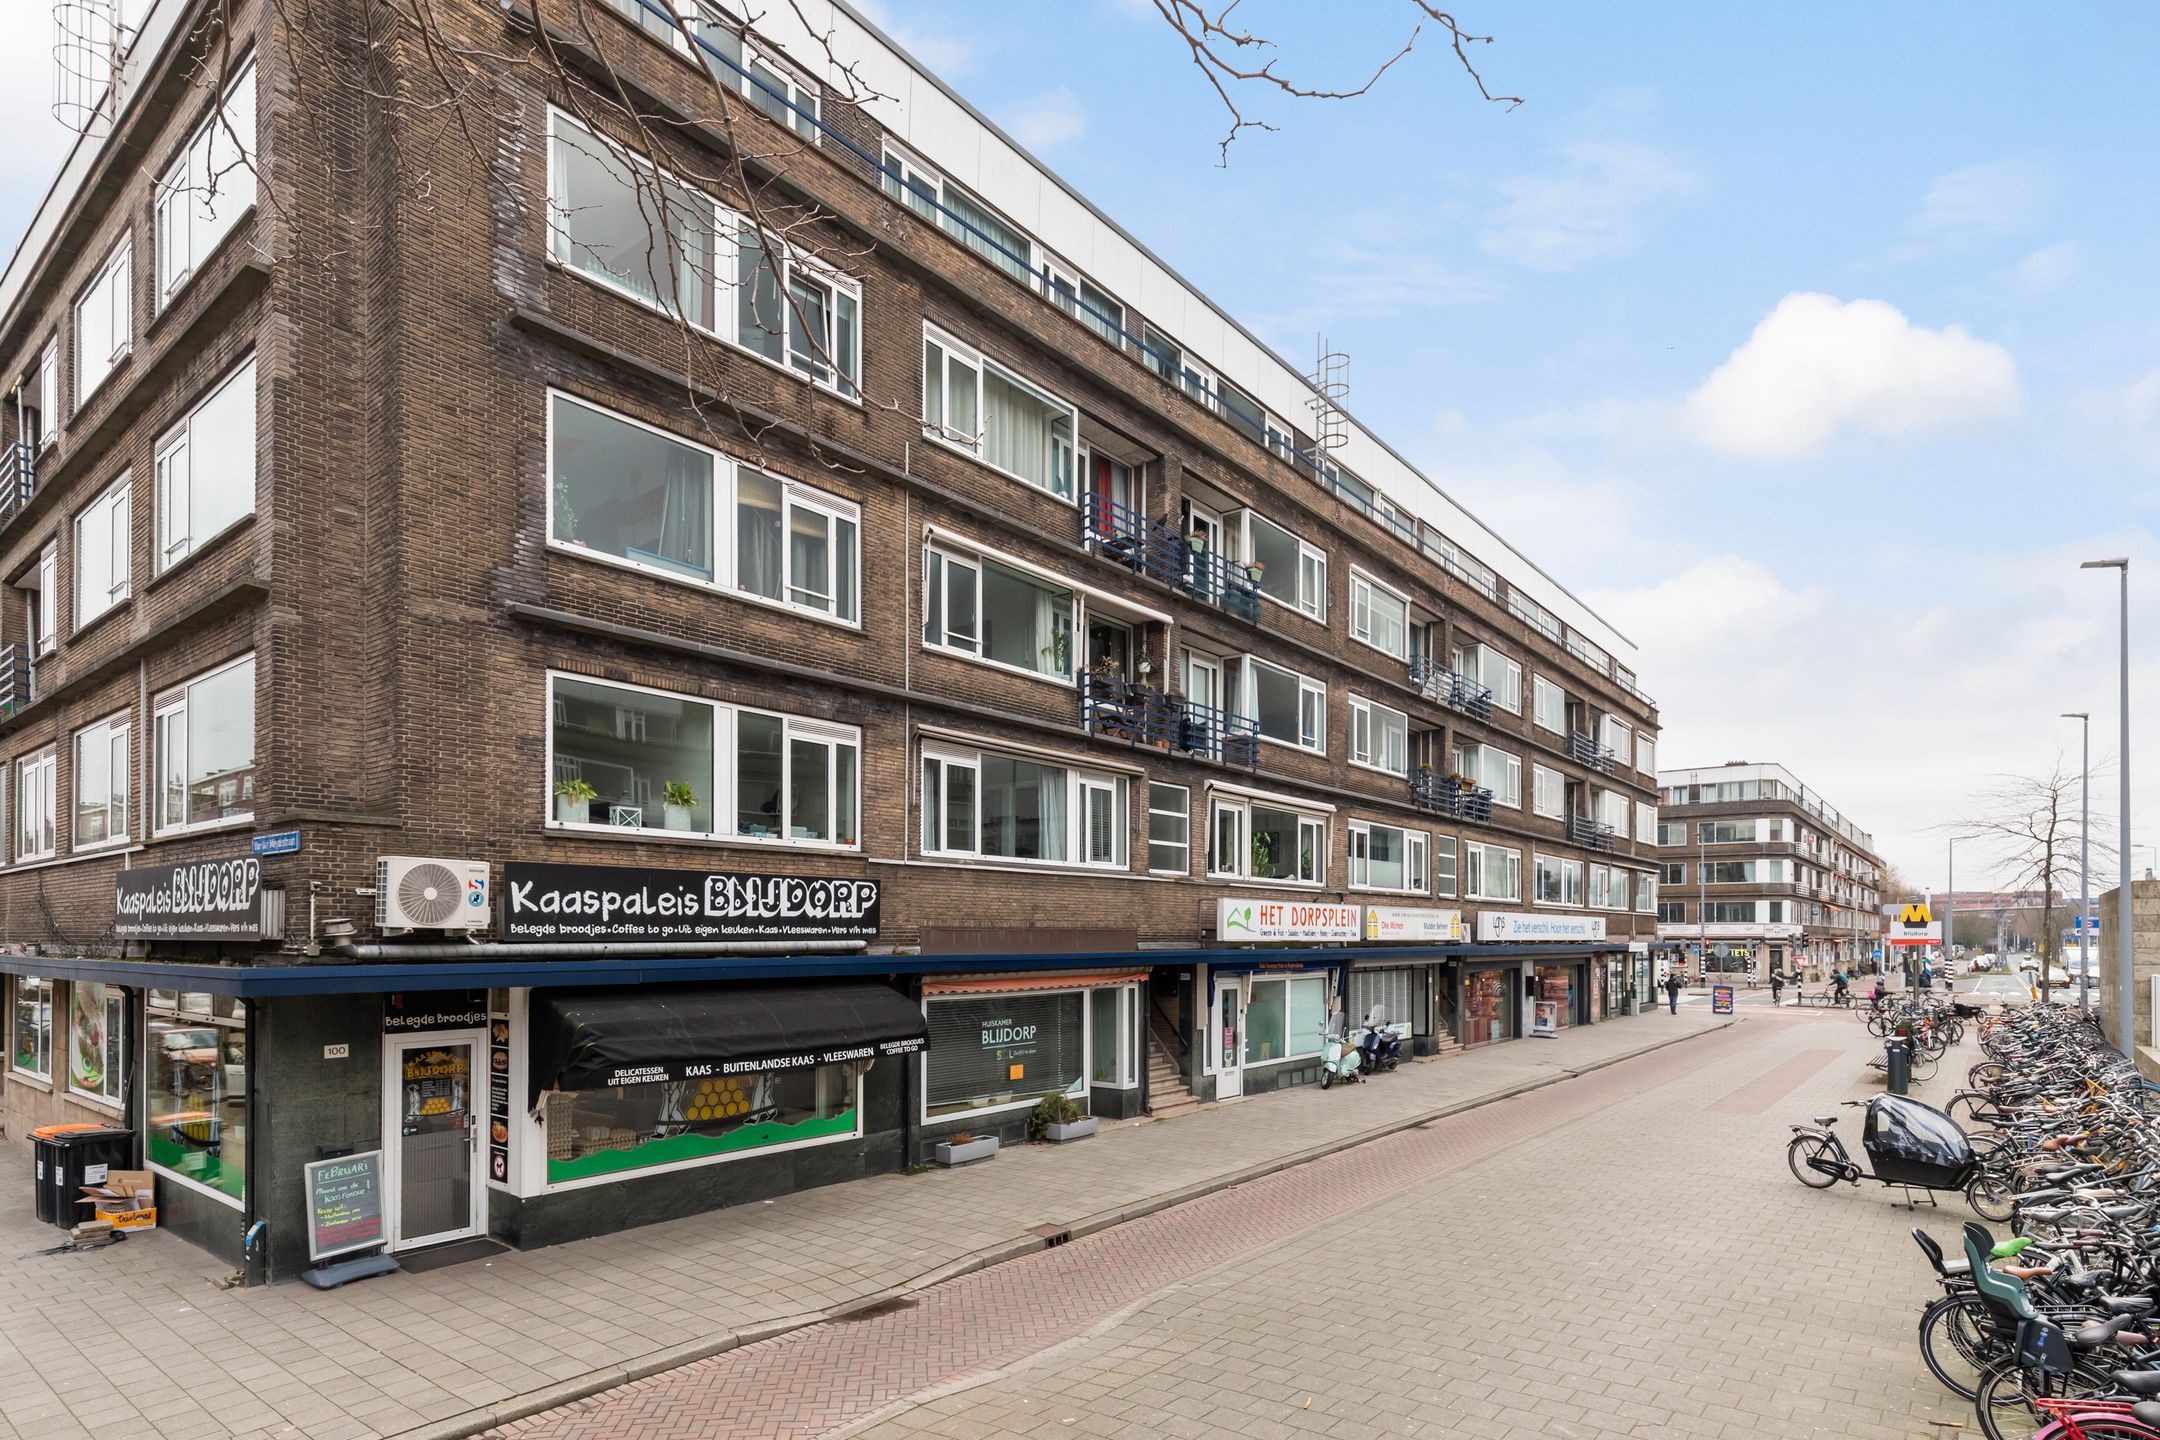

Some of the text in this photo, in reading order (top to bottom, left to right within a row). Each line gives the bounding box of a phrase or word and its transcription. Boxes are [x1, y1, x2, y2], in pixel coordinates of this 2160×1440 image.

[116, 882, 171, 921] Kaaspaleis
[510, 880, 699, 922] Kaaspaleis
[1260, 905, 1357, 927] HET DORPSPLEIN
[510, 923, 556, 937] Belegde
[559, 923, 608, 936] broodjes
[612, 923, 645, 934] Coffee
[648, 924, 660, 934] to
[662, 925, 674, 937] go
[678, 925, 693, 934] Uit
[695, 925, 719, 937] eigen
[721, 924, 756, 934] keuken
[758, 925, 779, 934] Kaas
[782, 925, 828, 934] Vleeswaren
[830, 925, 848, 934] Vers
[1513, 920, 1521, 934] Zie
[385, 1011, 487, 1028] Belegde Broodjes
[982, 1025, 1037, 1045] BLIJDORP
[328, 1046, 346, 1055] 100
[880, 1038, 925, 1050] BELEGDE BROODJES
[886, 1046, 903, 1056] COFFEE
[910, 1044, 919, 1052] GO
[685, 1064, 712, 1077] KAAS
[723, 1057, 791, 1074] BUITENLANDSE
[792, 1054, 815, 1067] KAAS
[823, 1047, 875, 1063] VLEESWAREN
[614, 1066, 664, 1078] DELICATESSEN
[607, 1073, 669, 1086] UIT EIGEN KEUKEN
